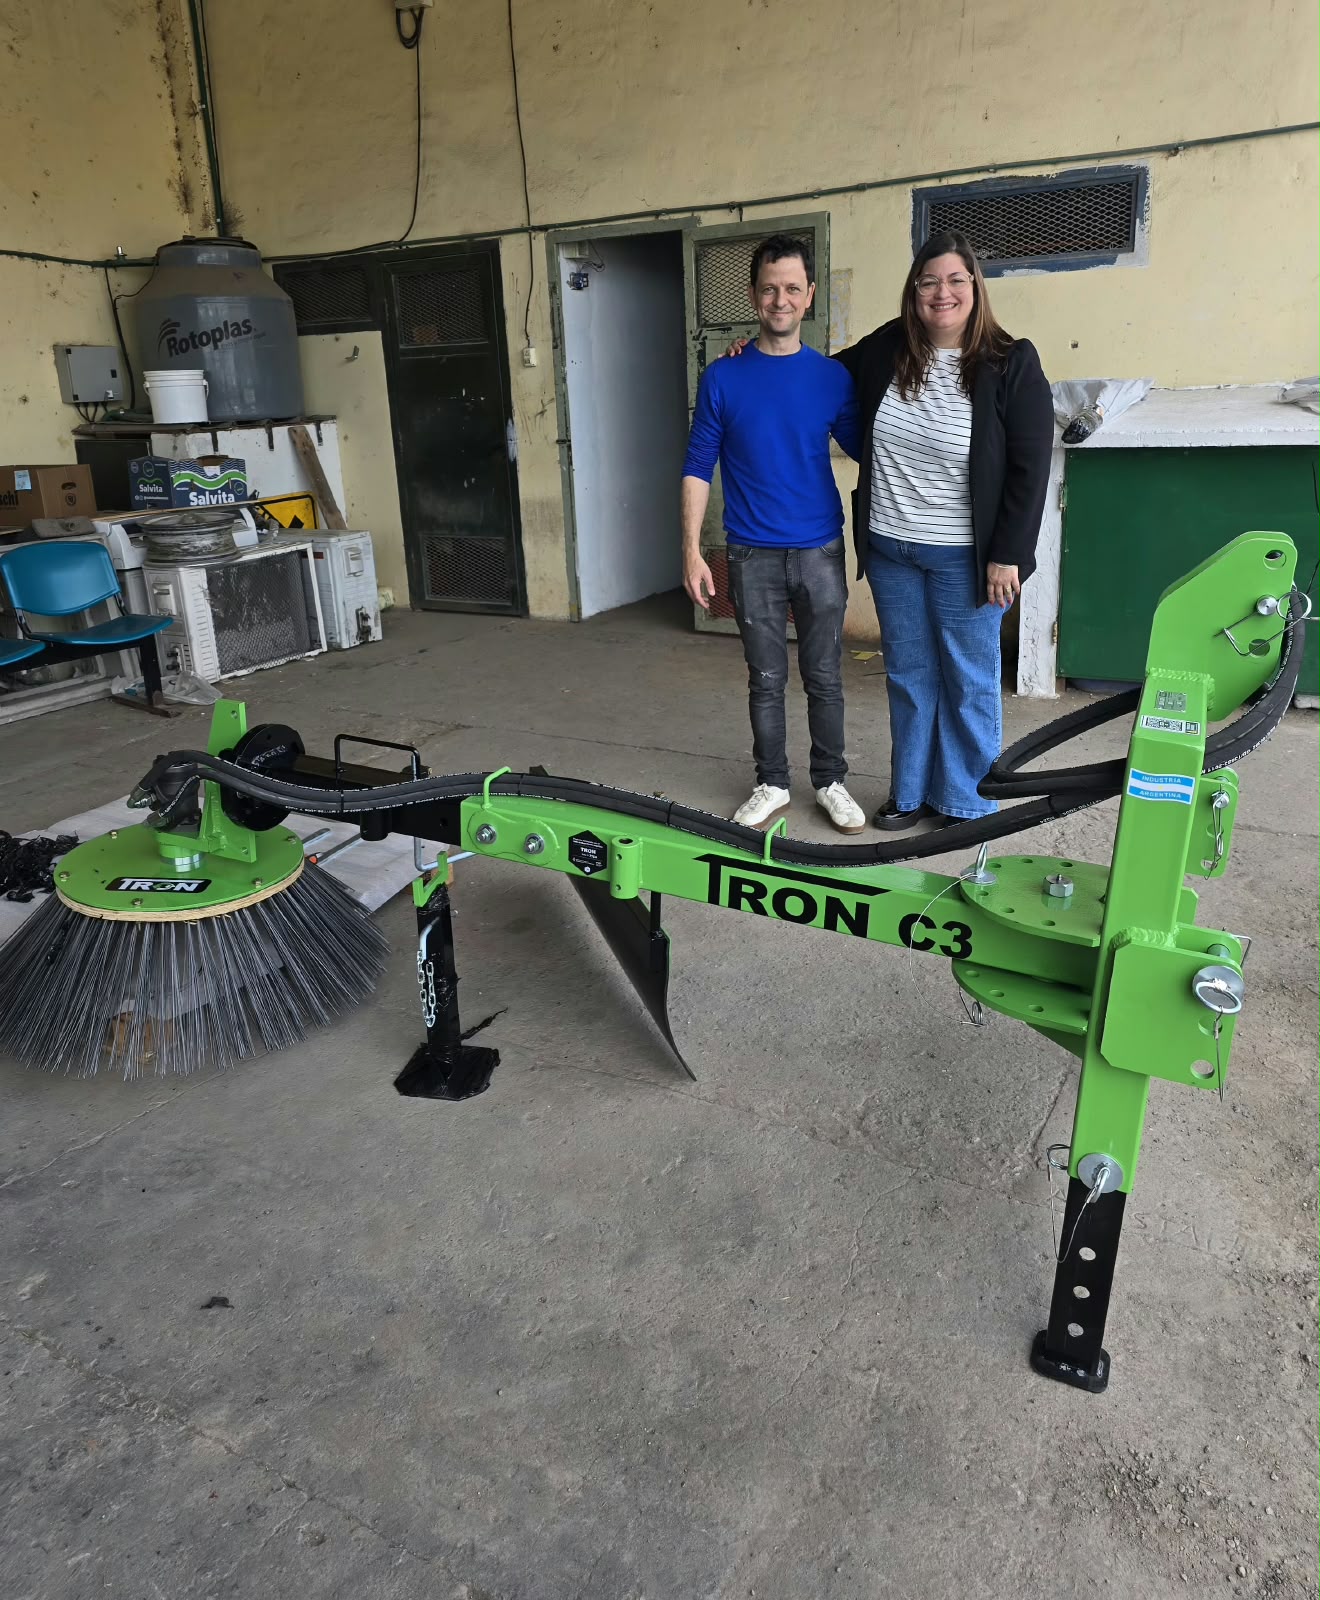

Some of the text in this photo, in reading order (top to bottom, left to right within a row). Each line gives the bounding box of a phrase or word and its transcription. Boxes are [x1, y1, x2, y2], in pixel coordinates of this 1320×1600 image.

[167, 319, 252, 357] Rotoplas
[139, 484, 163, 493] Salvita
[189, 490, 235, 506] Salvita
[1142, 775, 1181, 784] INDUSTRIA
[1139, 789, 1181, 799] ARGENTINA
[118, 878, 205, 892] TRON
[692, 853, 973, 960] TRON C3
